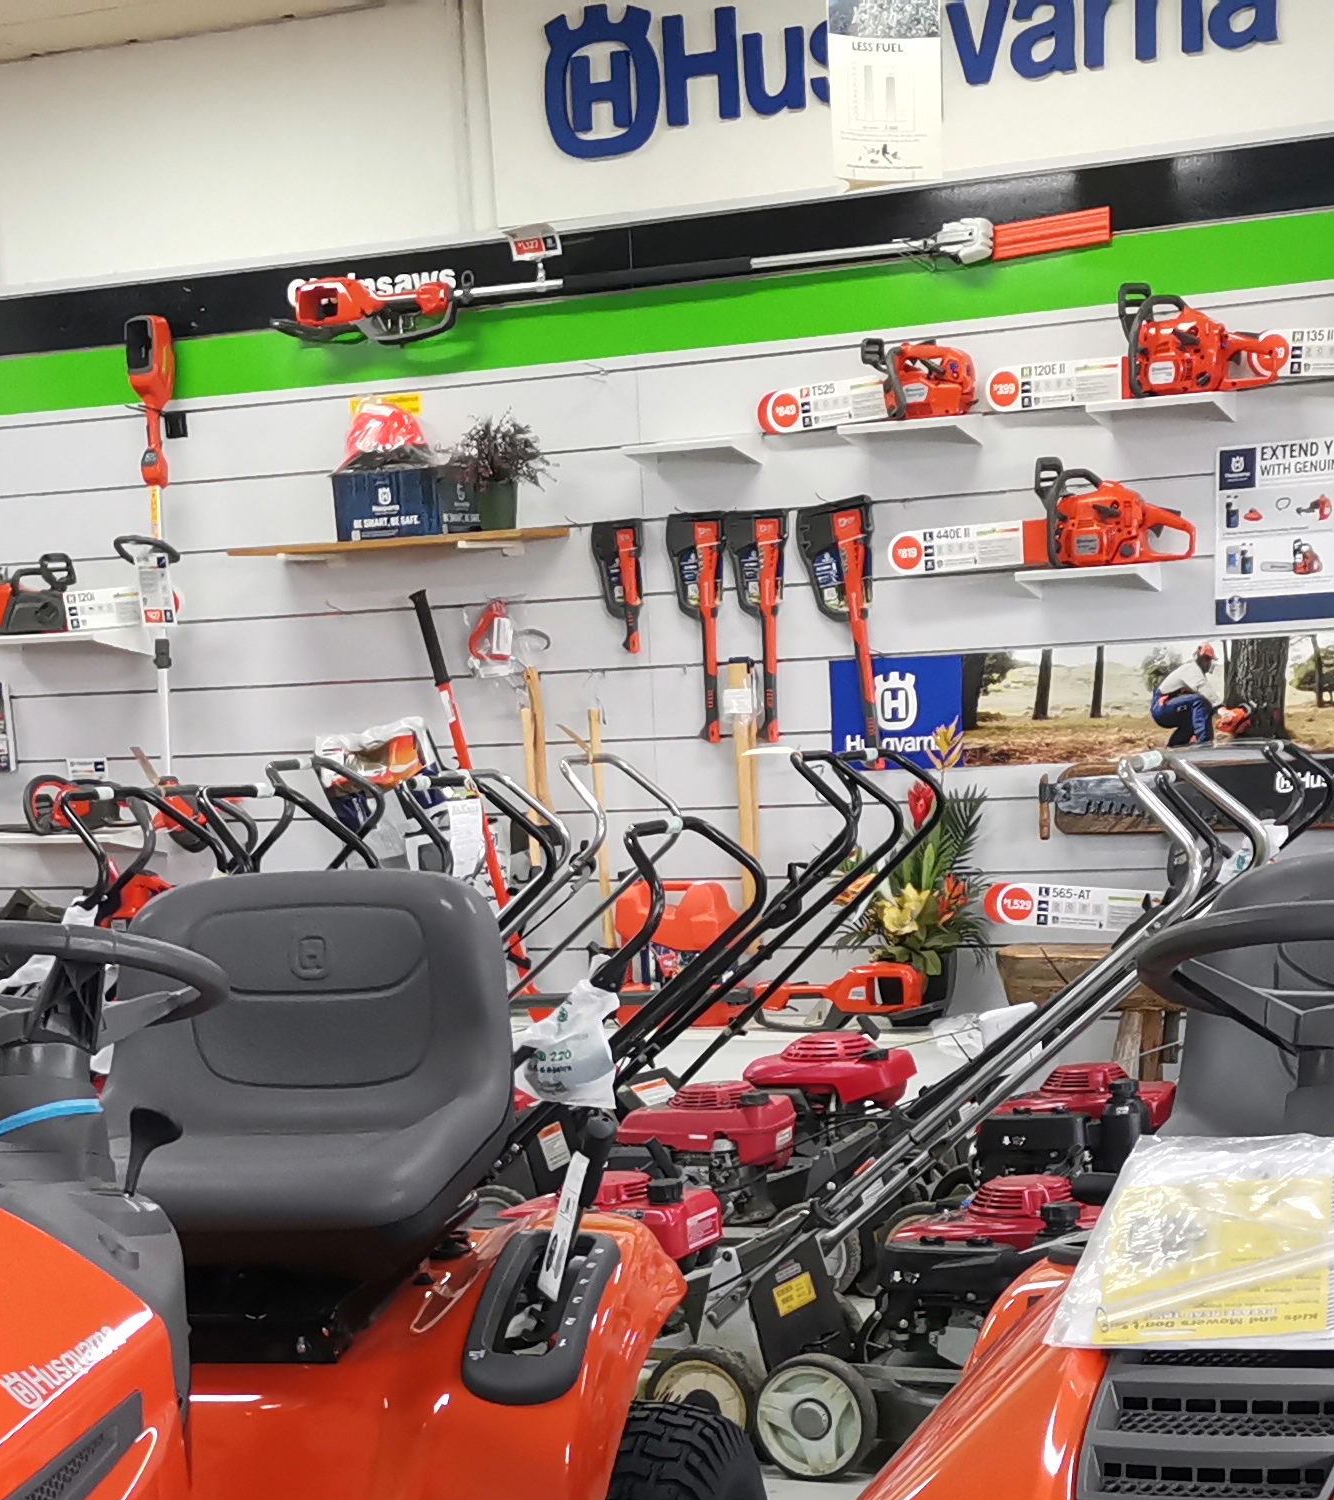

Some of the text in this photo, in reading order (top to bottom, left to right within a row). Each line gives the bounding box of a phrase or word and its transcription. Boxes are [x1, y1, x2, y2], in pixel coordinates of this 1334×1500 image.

[852, 41, 904, 53] LESS FUEL
[662, 0, 1278, 127] Husvarna
[1306, 330, 1325, 342] 135
[1260, 442, 1319, 461] EXTEND
[1259, 462, 1292, 476] WITH
[846, 734, 939, 753] Hqvarn
[1052, 888, 1092, 900] 565-AT
